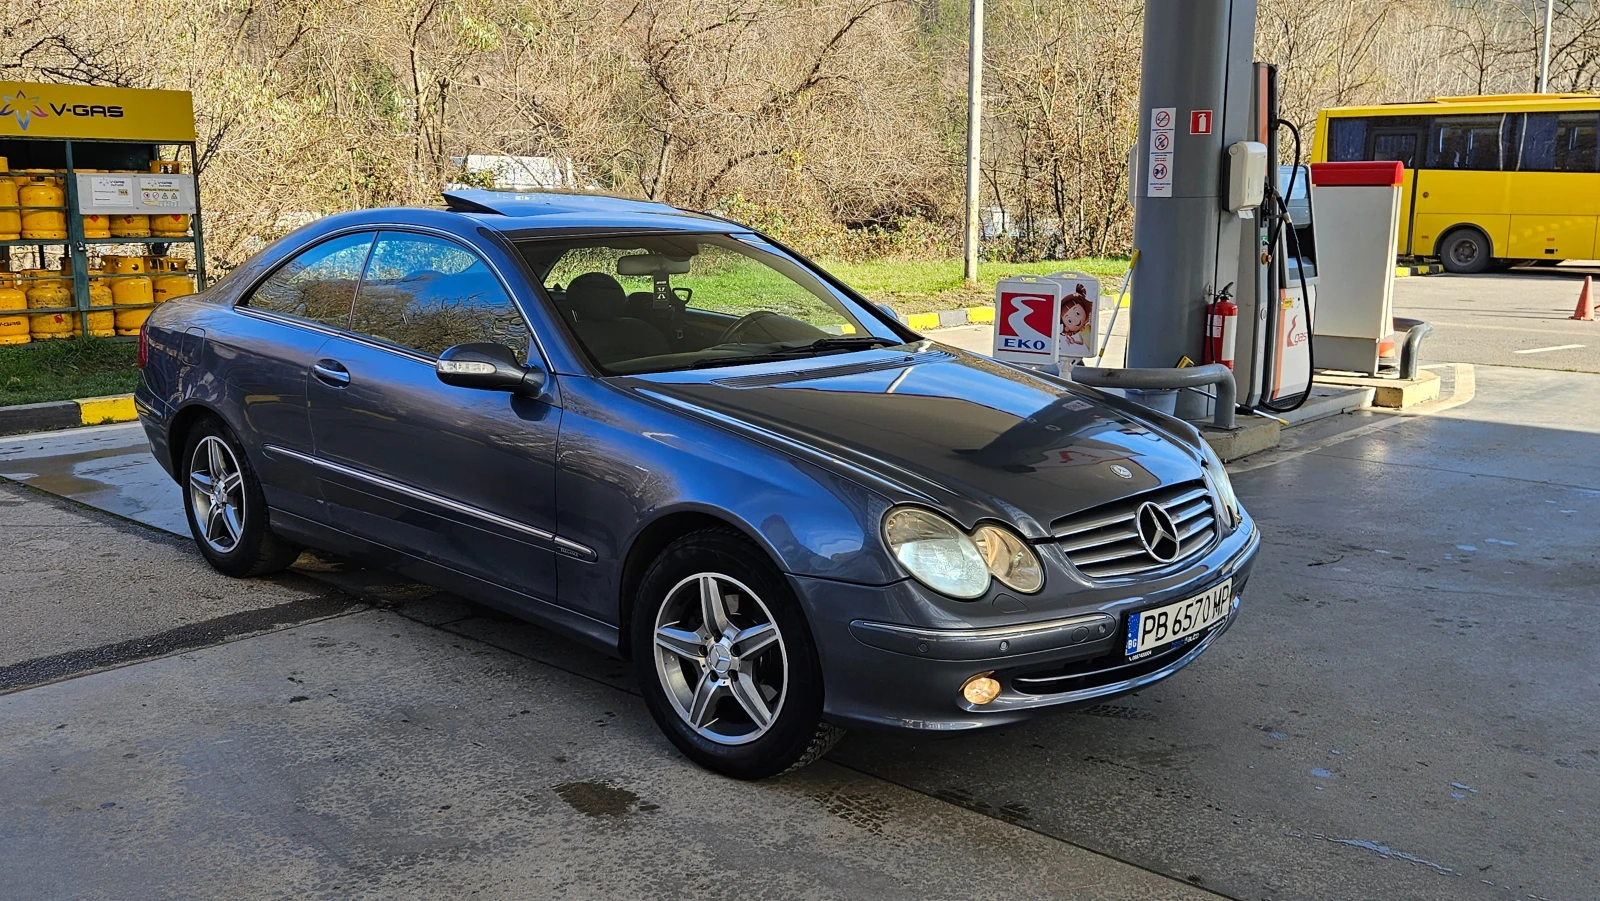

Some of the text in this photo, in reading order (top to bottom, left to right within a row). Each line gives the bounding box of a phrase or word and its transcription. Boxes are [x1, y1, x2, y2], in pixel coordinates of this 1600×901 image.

[50, 102, 124, 118] V-GAS
[1004, 338, 1046, 350] EKO
[1140, 584, 1230, 647] PB 6570 MP
[1127, 638, 1137, 650] BG
